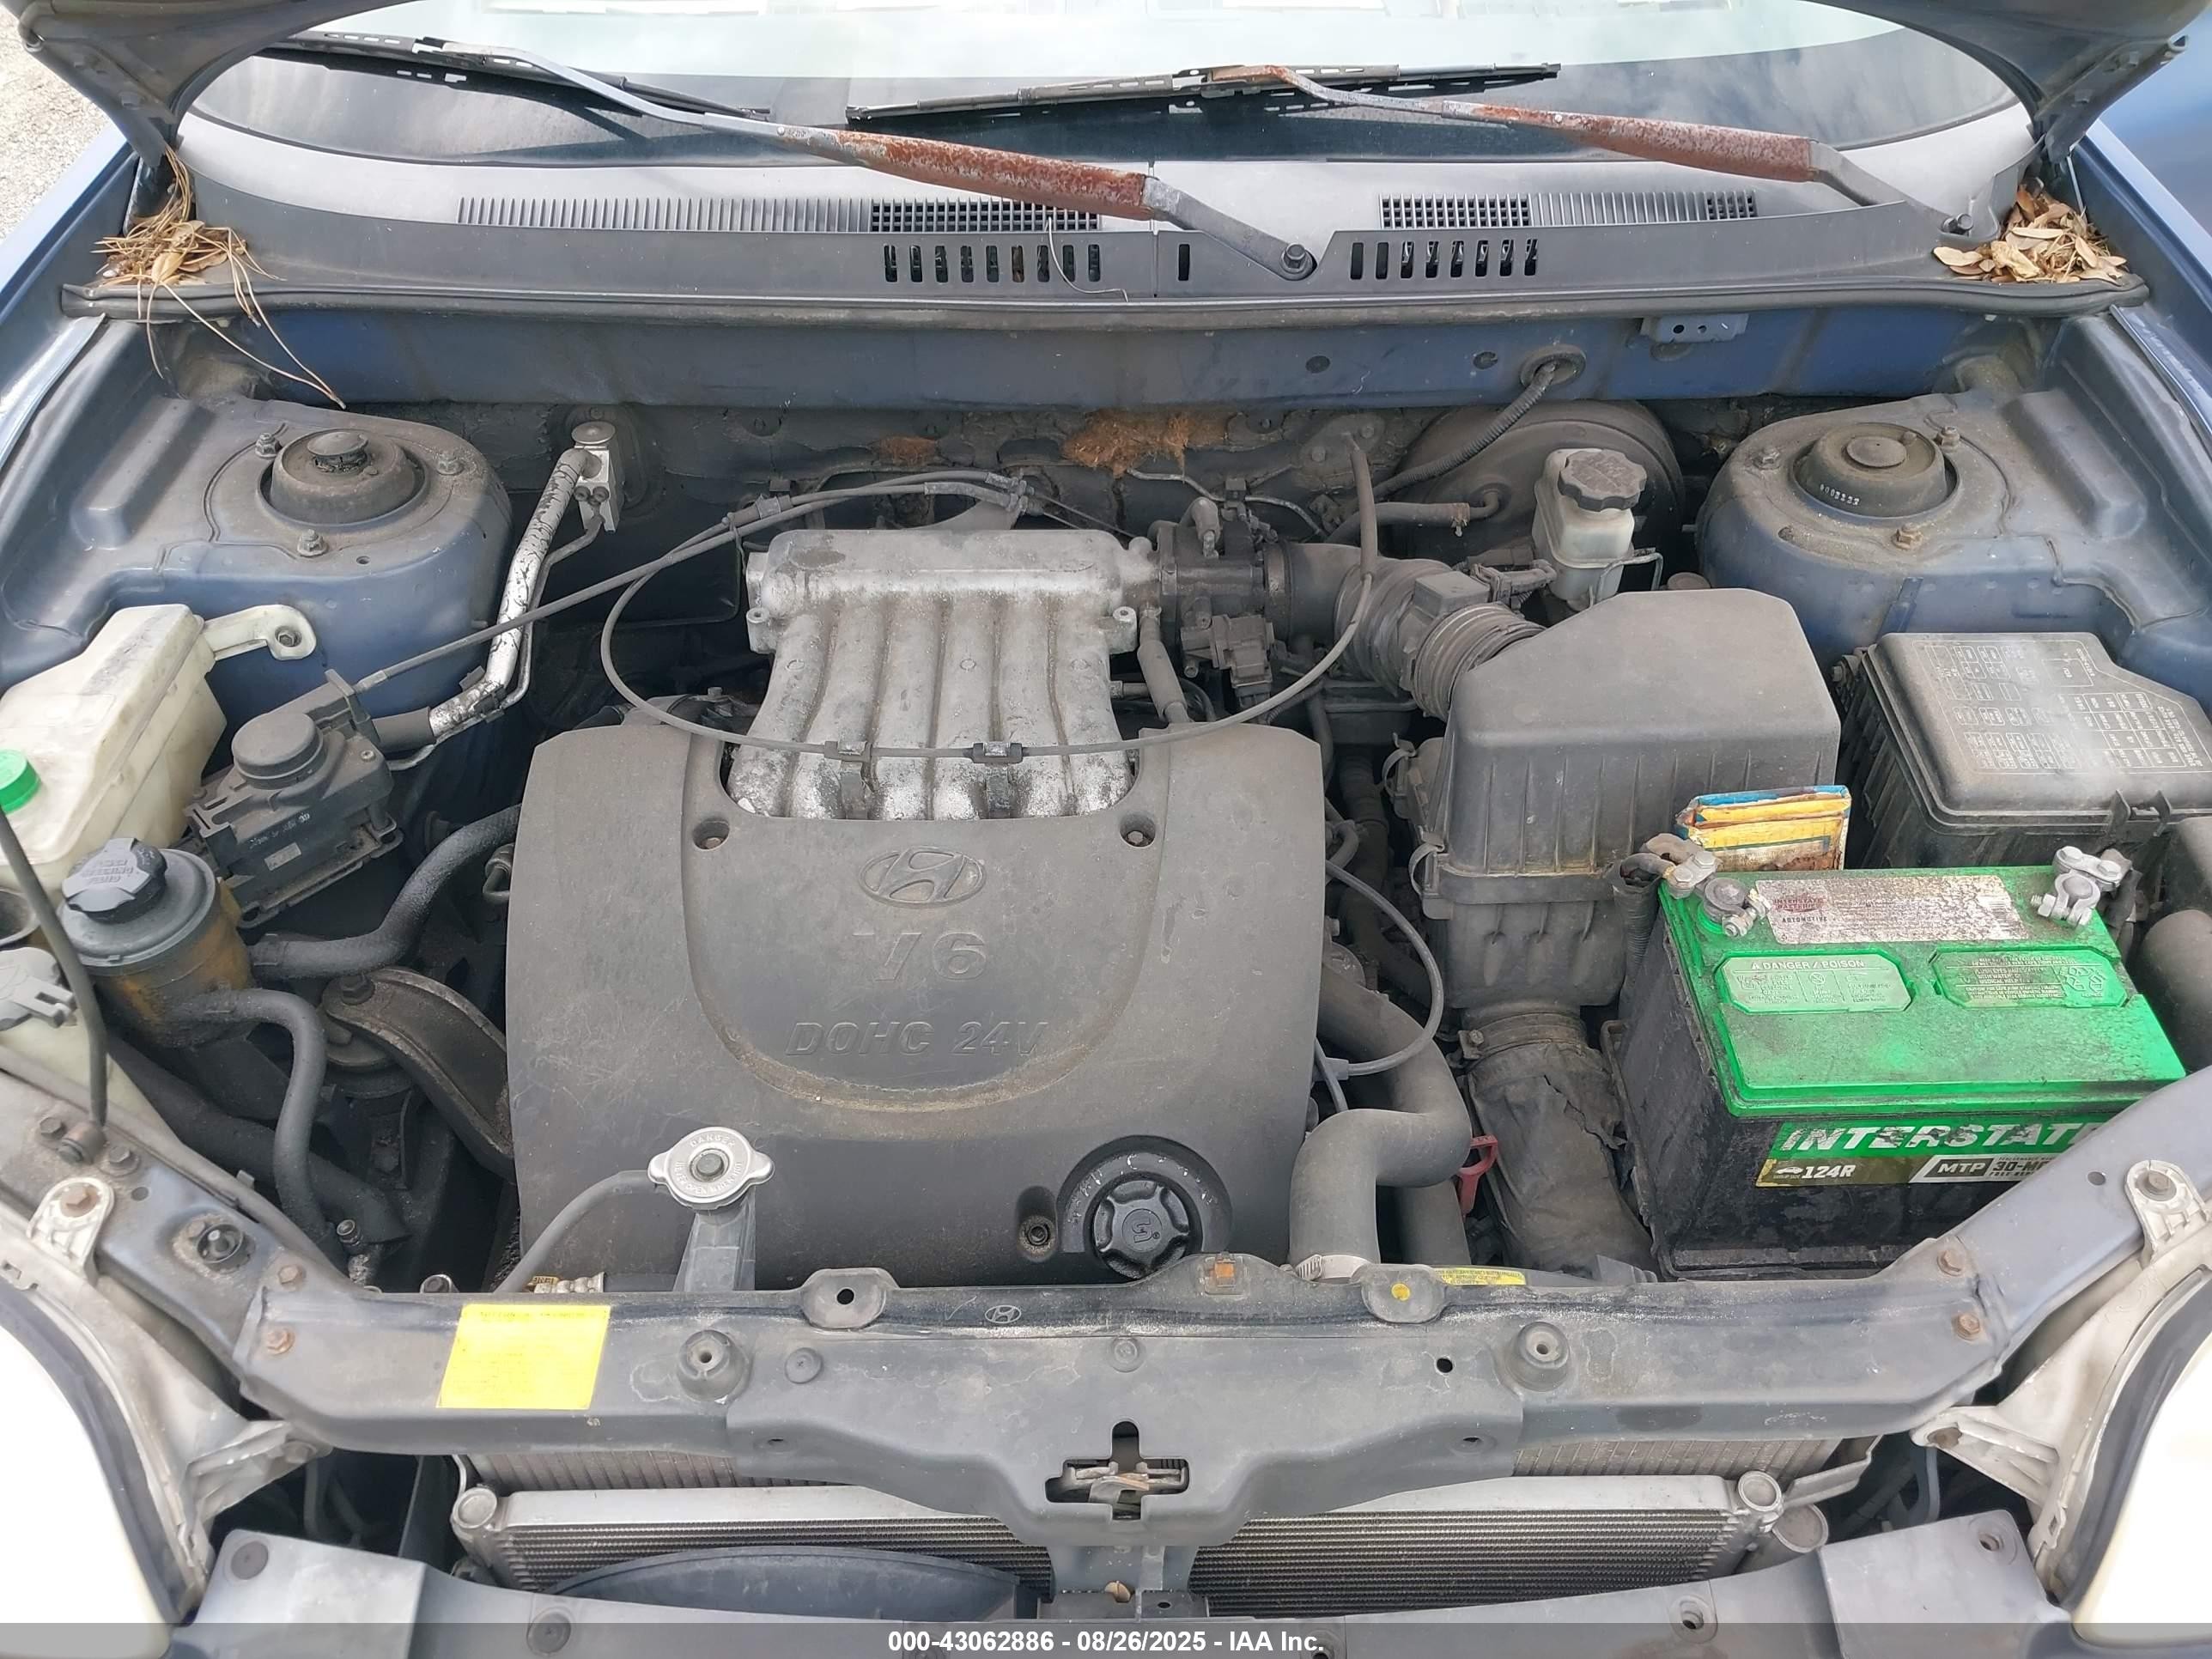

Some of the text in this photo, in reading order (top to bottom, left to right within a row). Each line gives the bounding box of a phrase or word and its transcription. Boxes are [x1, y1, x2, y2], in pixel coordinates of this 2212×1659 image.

[1762, 961, 1809, 969] DANGER
[1821, 960, 1865, 969] POISON
[785, 1021, 1048, 1056] DOHC 24V
[690, 1133, 735, 1147] DANGER
[1802, 1164, 1856, 1179] 124R
[1937, 1162, 1986, 1174] MTP
[685, 1182, 708, 1194] OPEN
